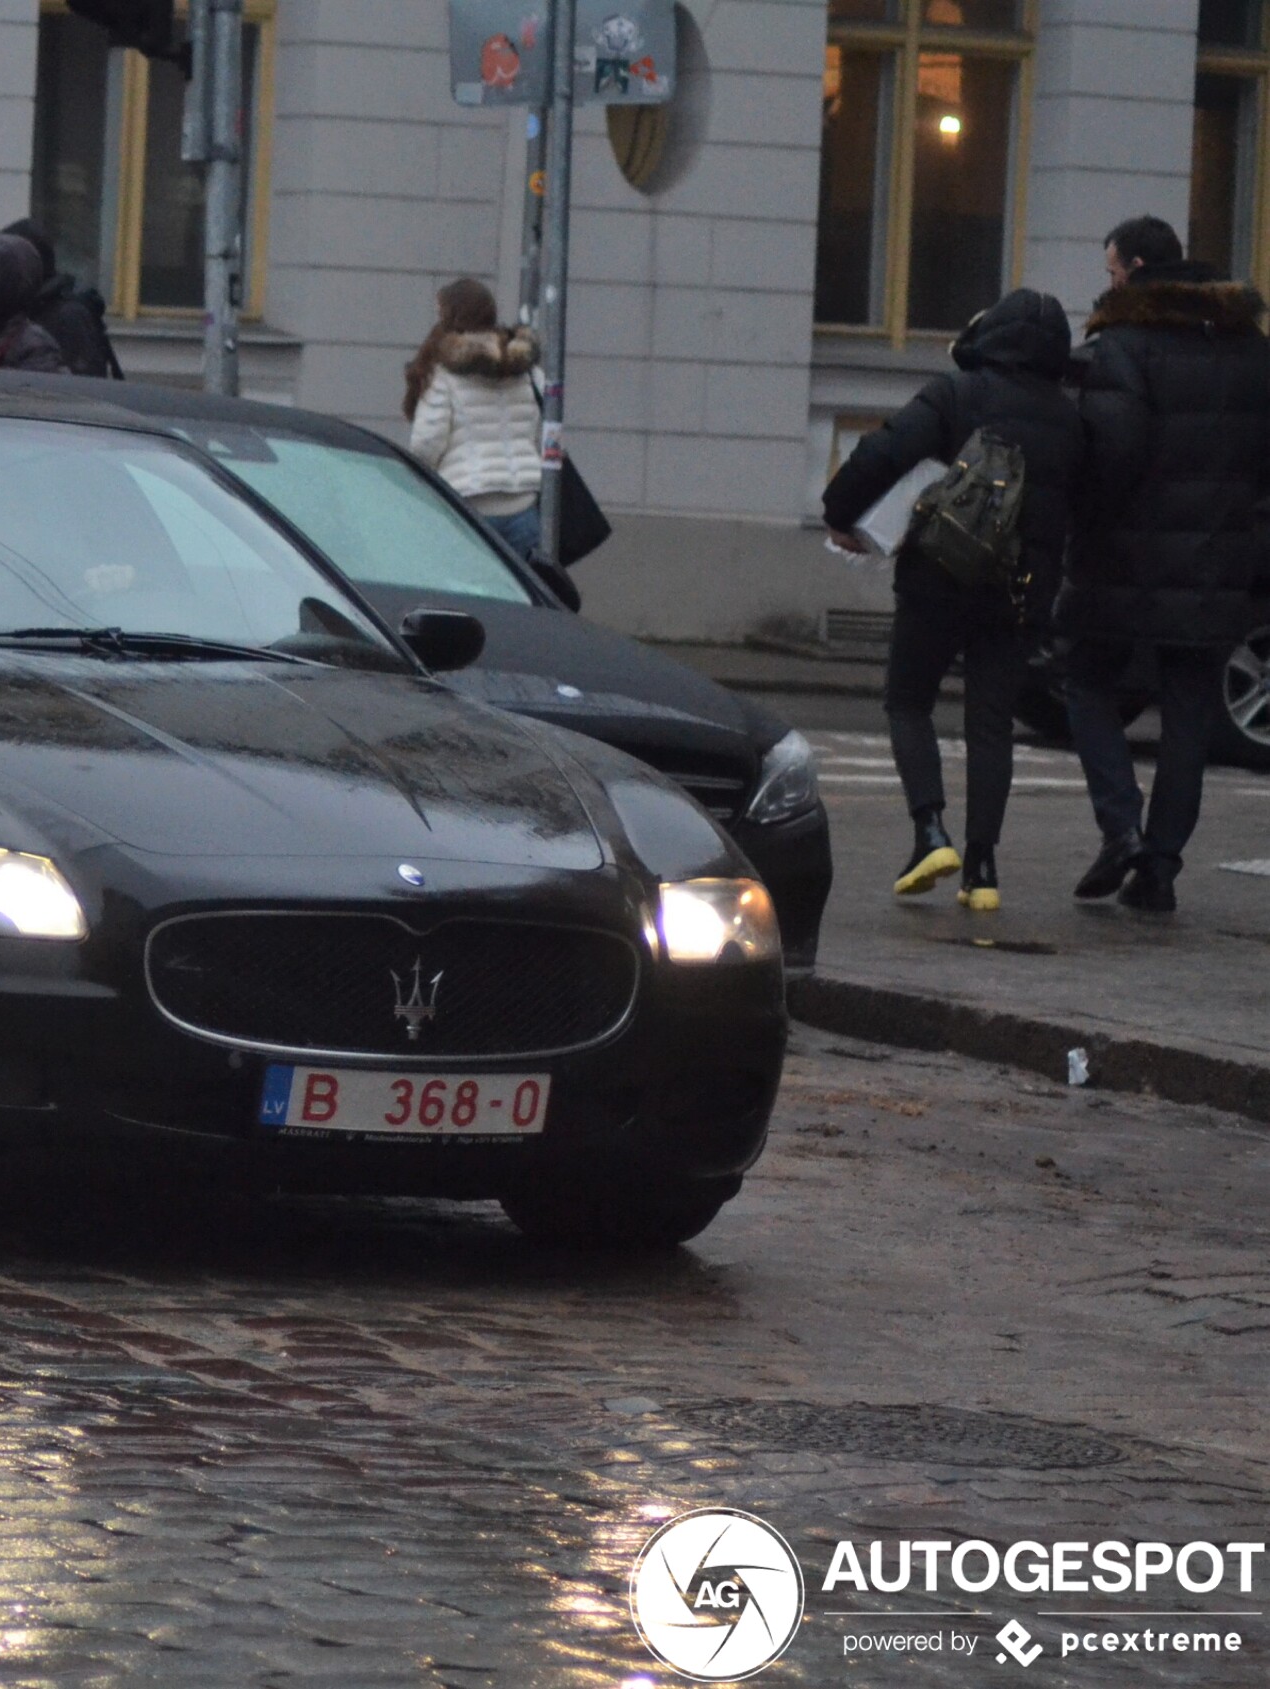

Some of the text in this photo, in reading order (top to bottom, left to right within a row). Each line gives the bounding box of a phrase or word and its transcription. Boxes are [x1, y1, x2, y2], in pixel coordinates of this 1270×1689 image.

[263, 1101, 285, 1115] LV
[302, 1073, 541, 1128] B 368-0
